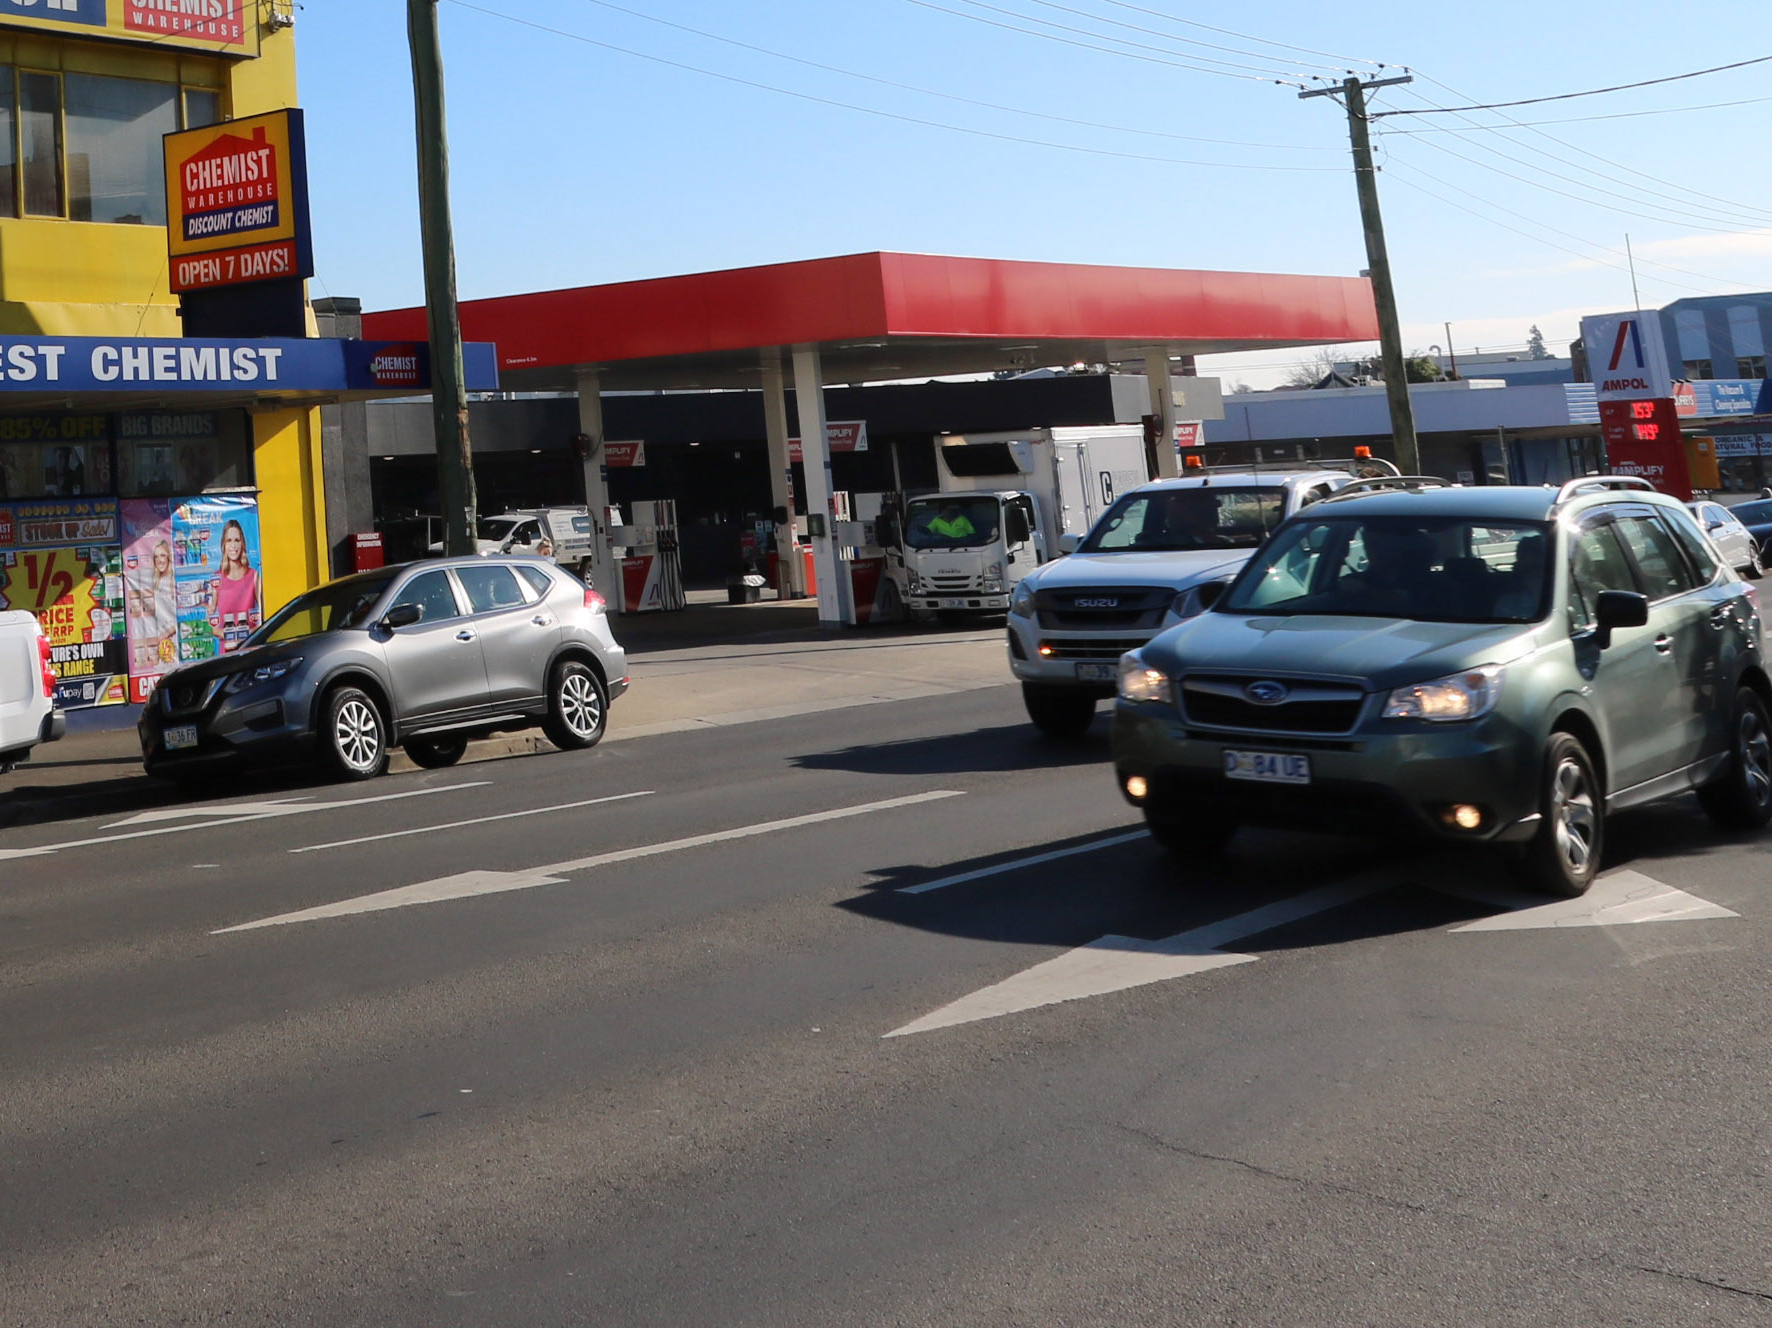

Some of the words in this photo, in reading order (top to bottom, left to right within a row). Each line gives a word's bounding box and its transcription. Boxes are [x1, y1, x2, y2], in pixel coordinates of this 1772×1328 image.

[133, 11, 239, 38] WAREHOUSE
[185, 148, 270, 193] CHEMIST
[187, 182, 273, 210] WAREHOUSE
[188, 212, 234, 236] DISCOUNT
[234, 204, 274, 228] CHEMIST
[178, 258, 222, 286] OPEN
[225, 255, 235, 280] 7
[240, 247, 289, 278] DAYS!
[91, 345, 283, 382] CHEMIST
[375, 356, 417, 371] CHEMIST
[376, 371, 416, 380] WAREHOUSE
[1601, 378, 1649, 391] AMPOL
[61, 415, 106, 437] OFF
[121, 419, 148, 437] BIG
[151, 413, 214, 436] BRANDS
[1617, 465, 1664, 476] AMPLIFY
[1074, 599, 1118, 607] ISUZU
[54, 625, 74, 637] RRP
[80, 642, 104, 659] OWN
[63, 660, 95, 676] RANGE
